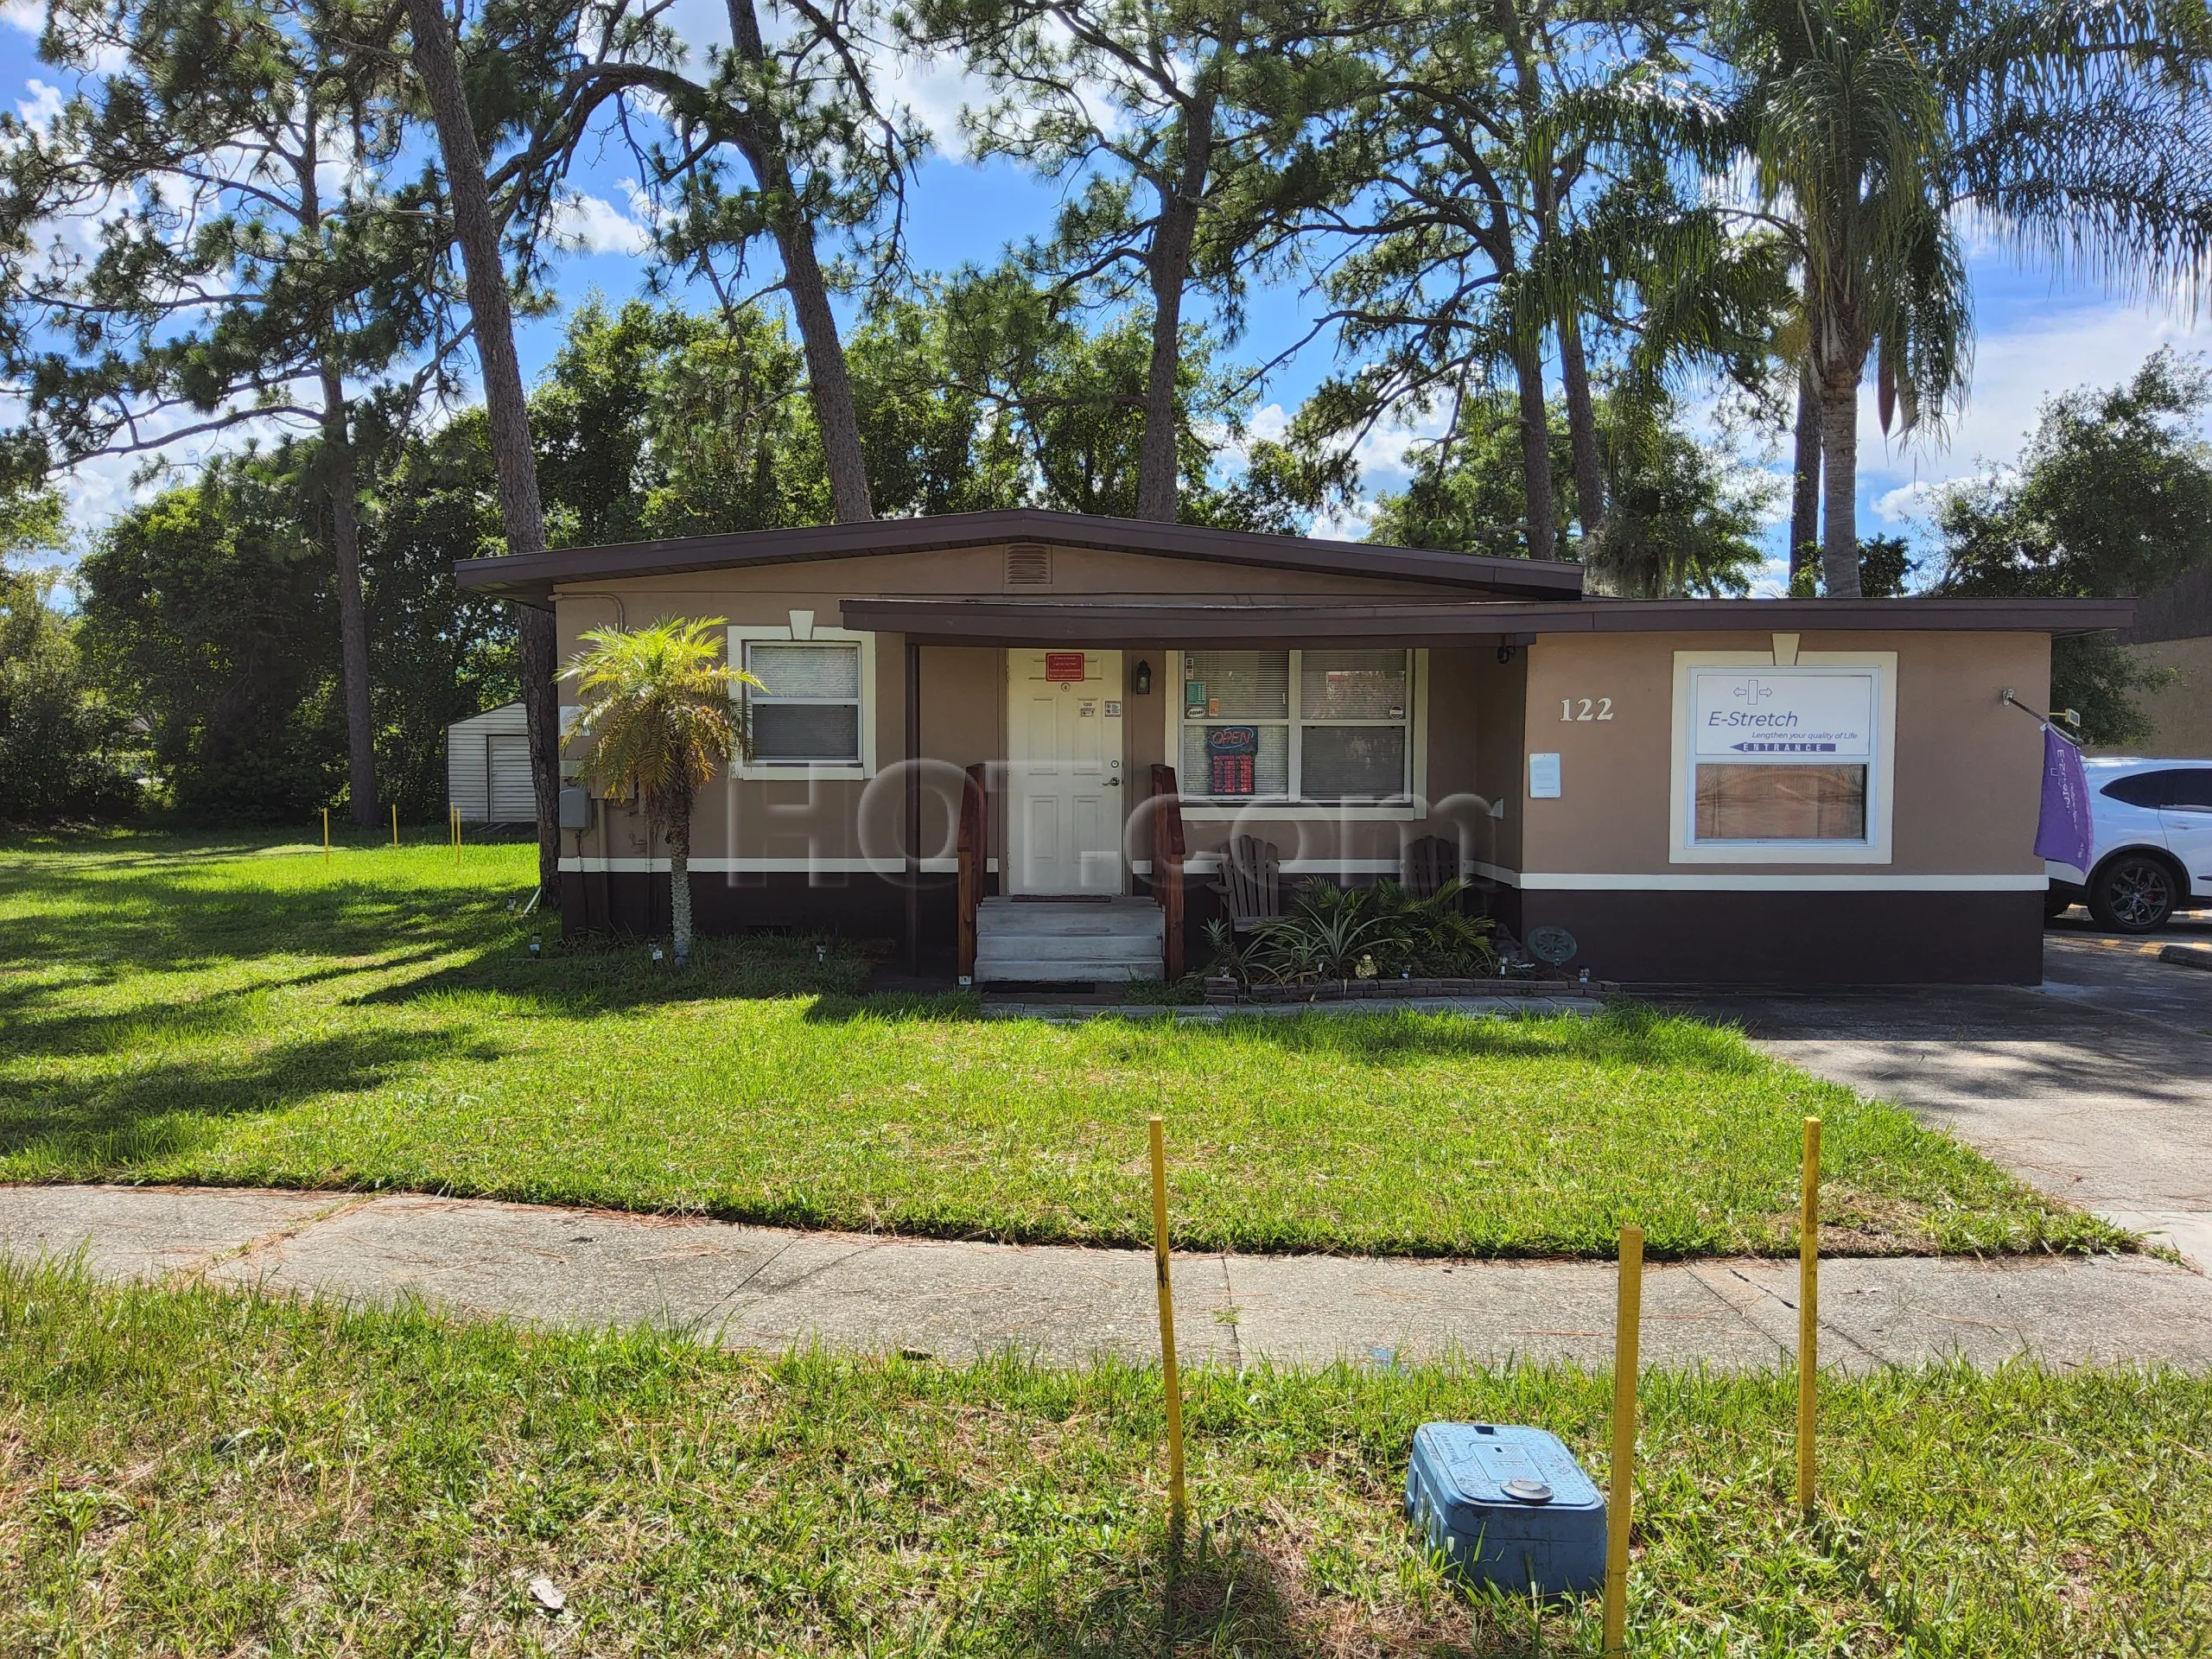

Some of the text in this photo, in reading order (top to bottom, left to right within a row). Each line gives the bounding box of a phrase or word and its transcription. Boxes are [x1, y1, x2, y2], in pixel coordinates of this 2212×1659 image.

[1560, 697, 1614, 721] 122
[1708, 711, 1798, 727] E-Stretch
[1212, 731, 1251, 745] OPEN
[1808, 732, 1833, 741] quality
[1743, 743, 1821, 752] ENTRANCE
